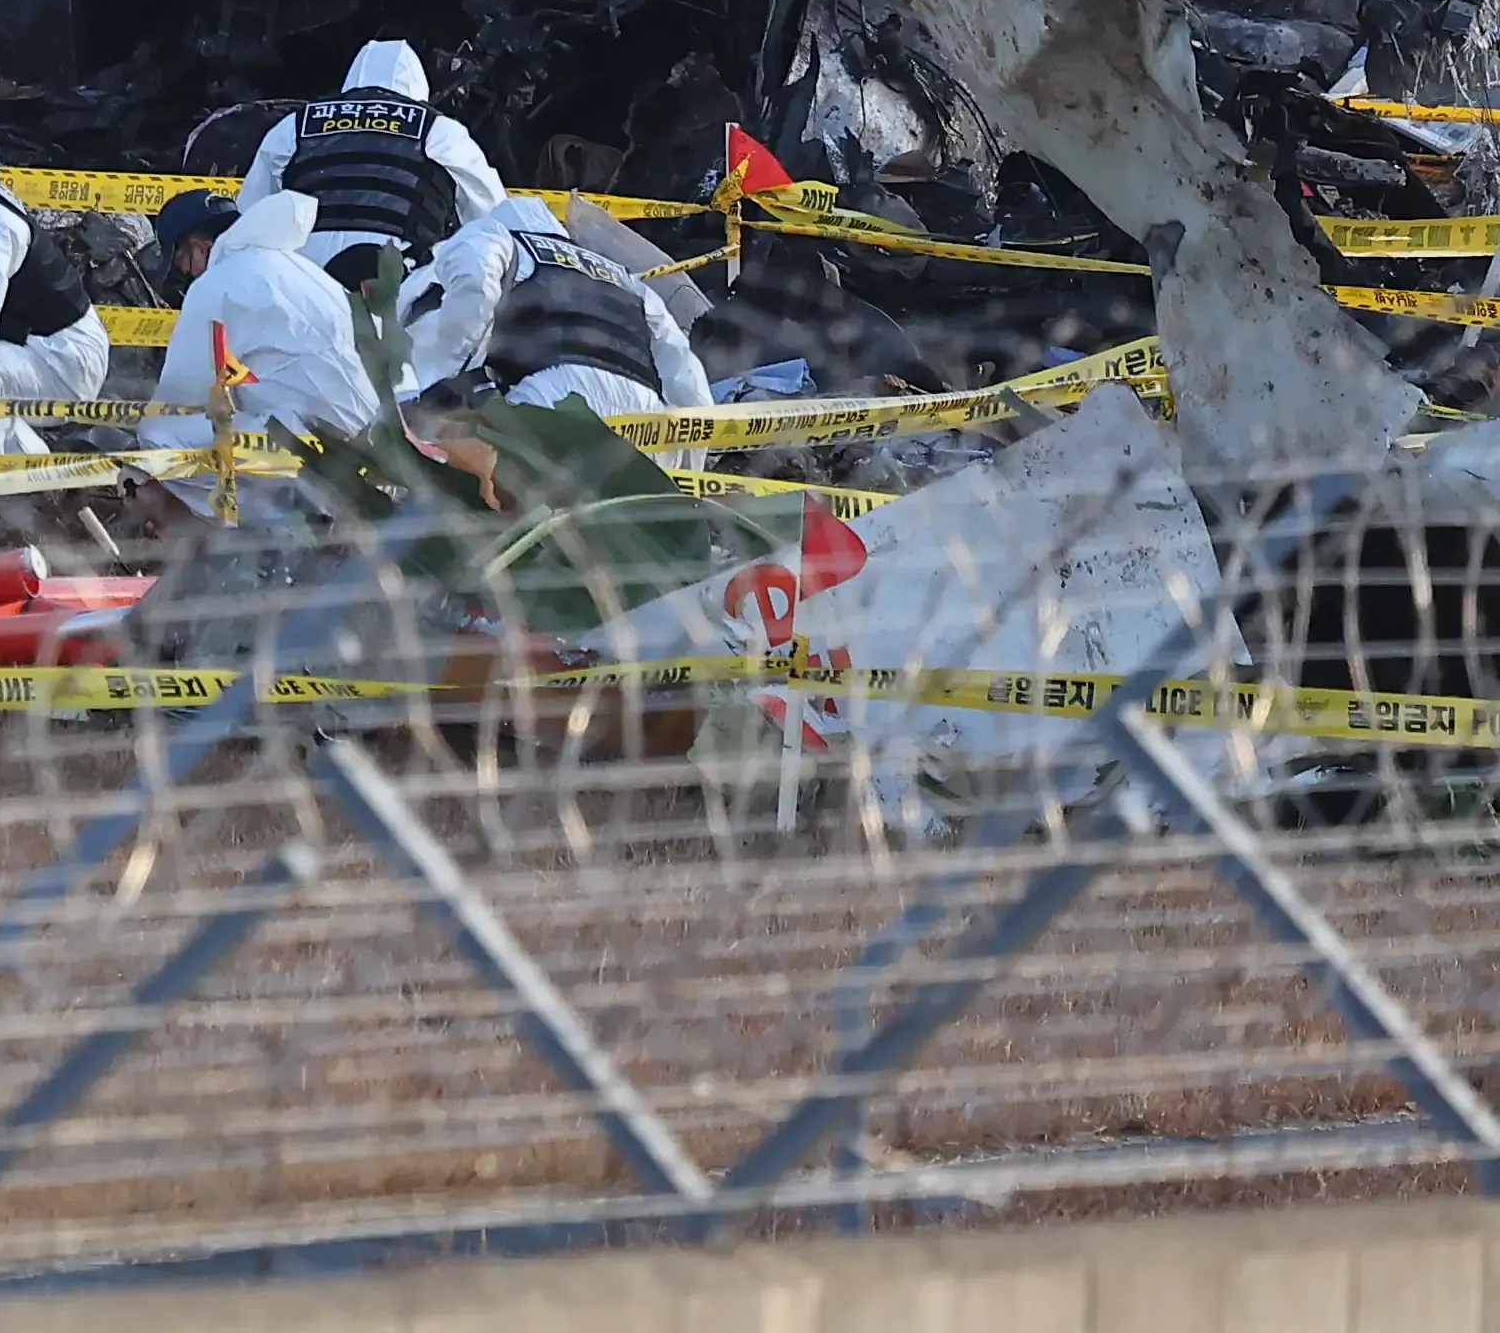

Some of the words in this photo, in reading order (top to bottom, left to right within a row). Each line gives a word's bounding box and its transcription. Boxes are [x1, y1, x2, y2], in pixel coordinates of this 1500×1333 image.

[312, 104, 417, 123] 과학수사
[322, 118, 401, 133] POLICE
[1347, 699, 1456, 735] 출입금지
